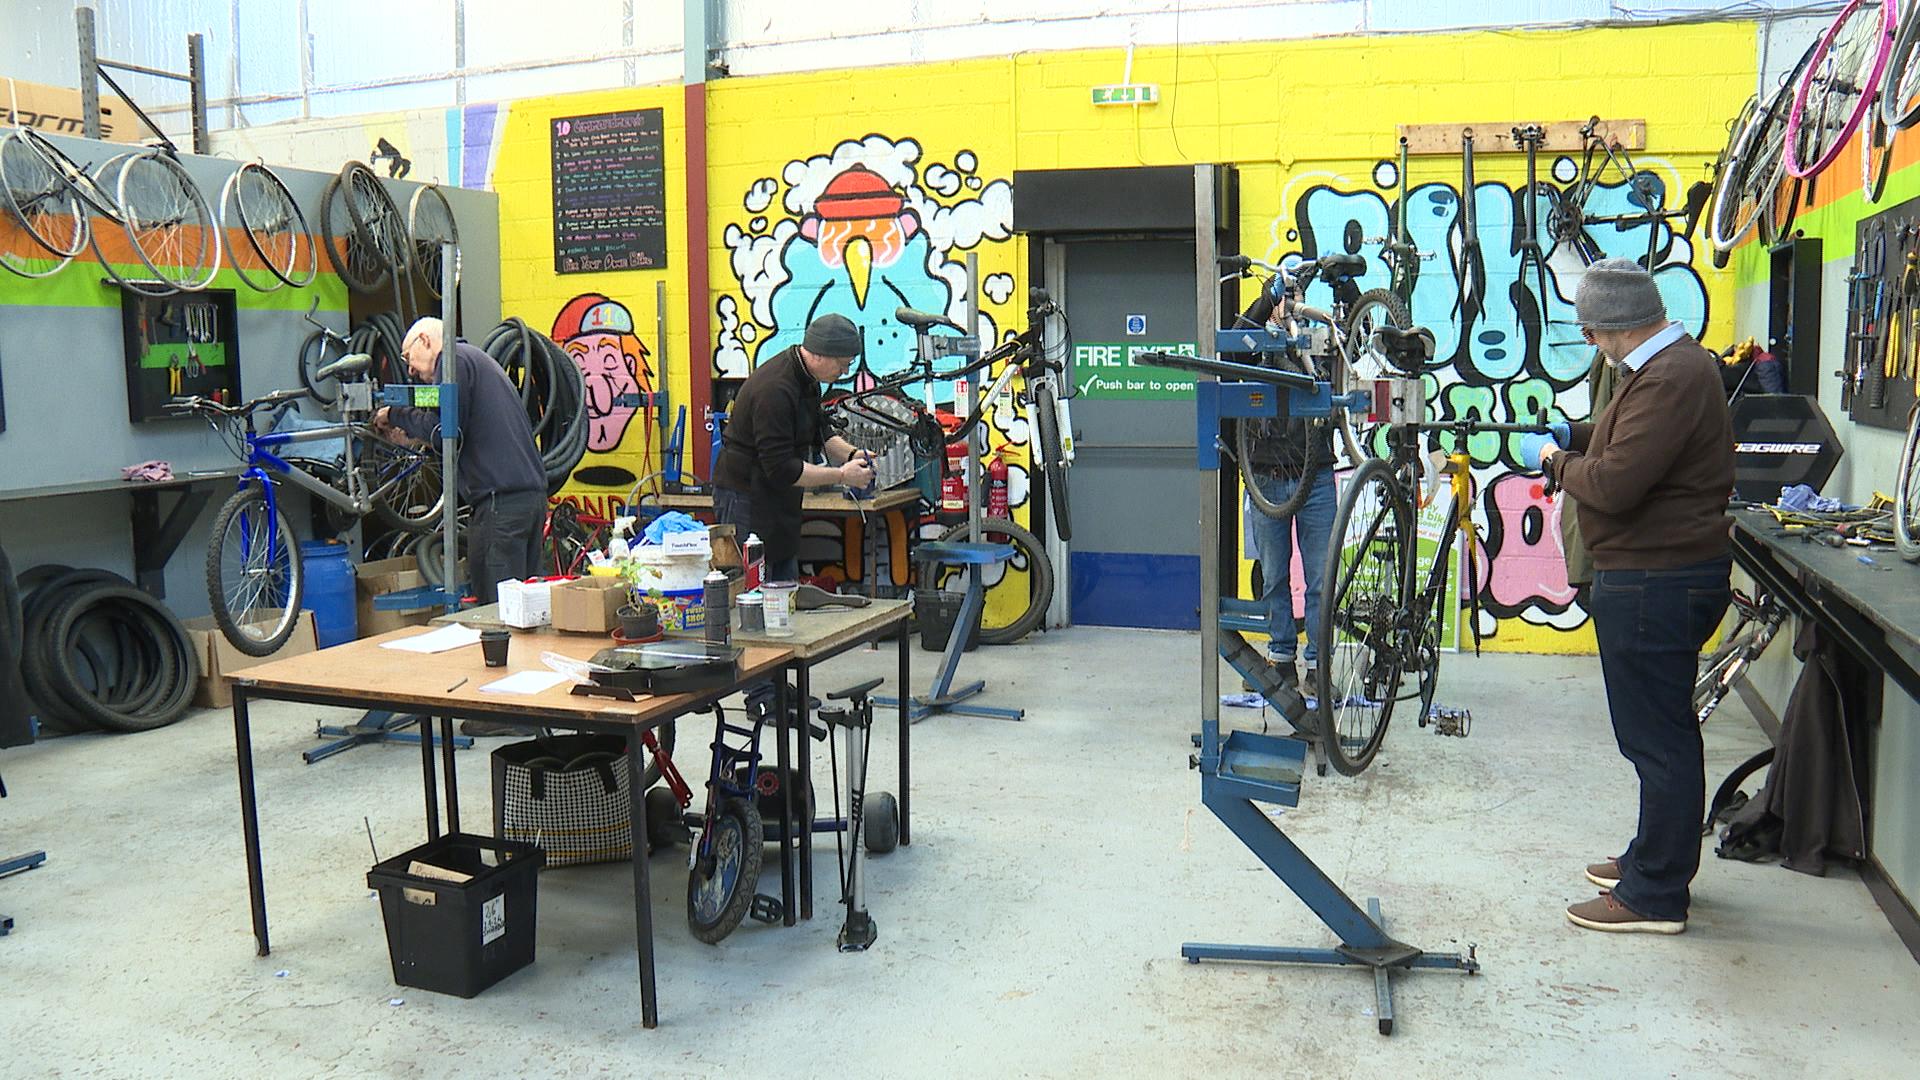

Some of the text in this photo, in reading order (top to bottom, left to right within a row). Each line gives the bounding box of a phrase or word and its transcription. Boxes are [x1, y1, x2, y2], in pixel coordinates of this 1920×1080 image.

[556, 120, 571, 136] 10
[1076, 346, 1121, 366] FIRE
[1096, 379, 1194, 392] Push bar to open
